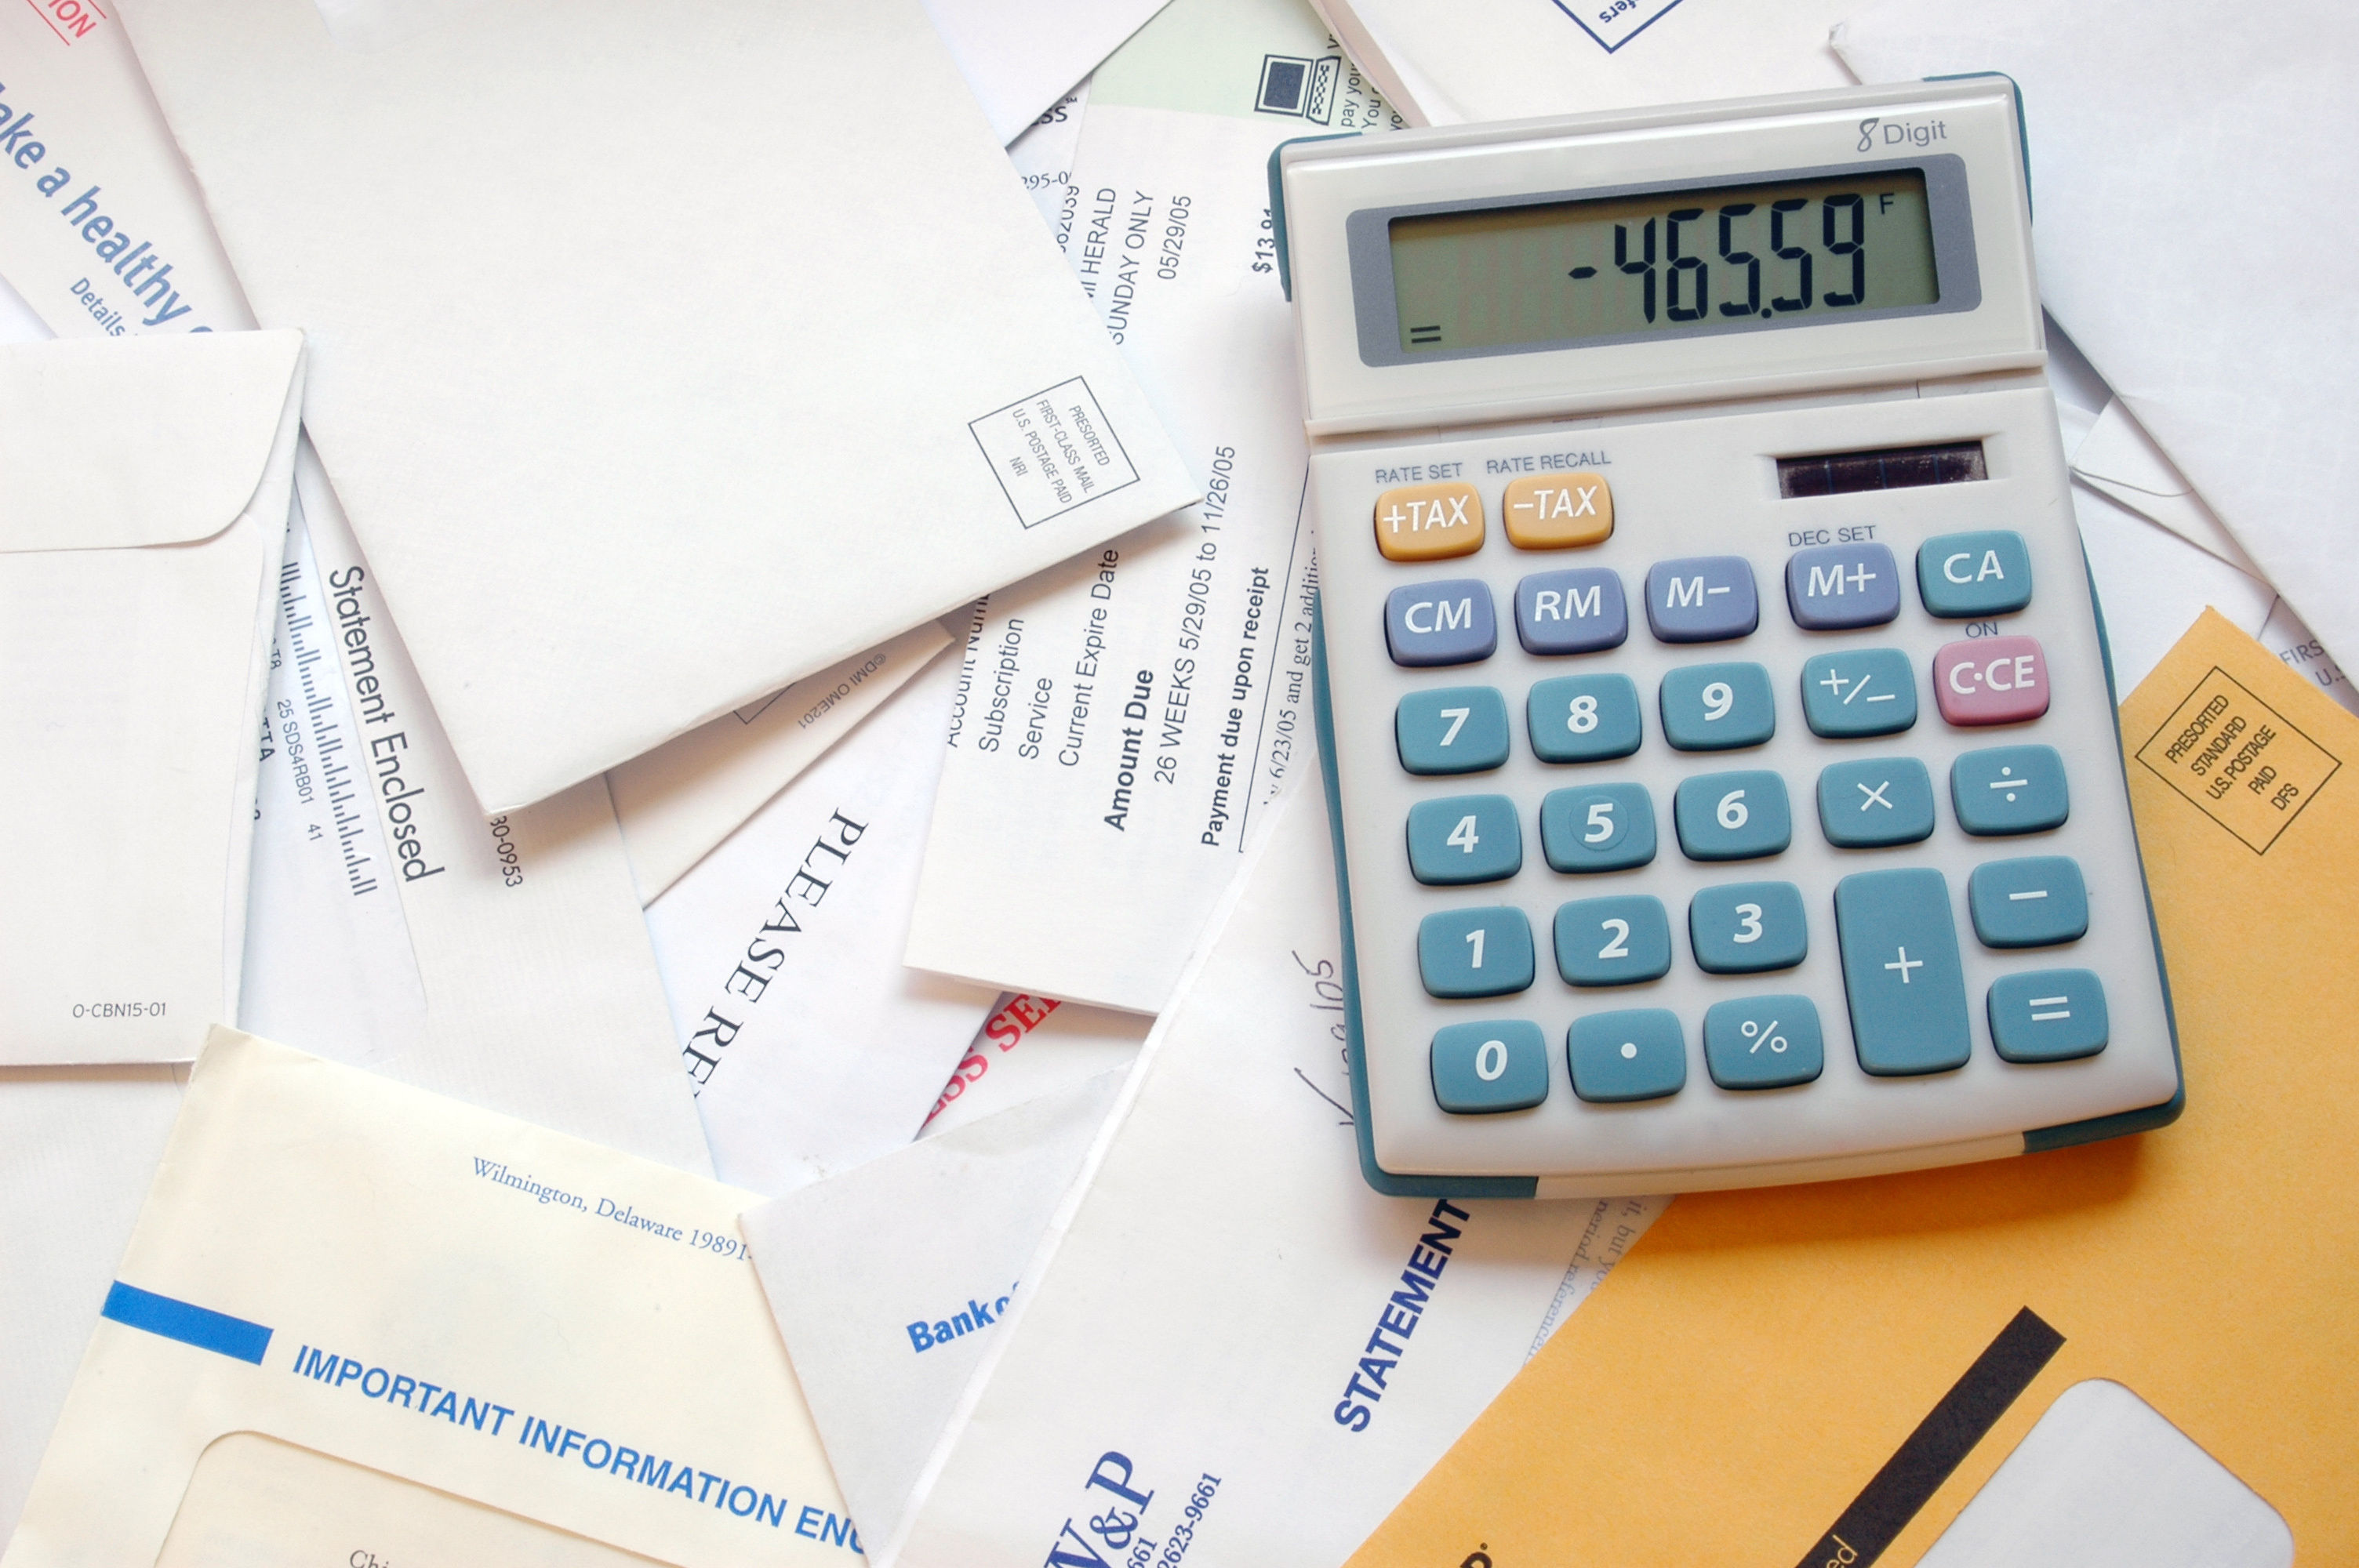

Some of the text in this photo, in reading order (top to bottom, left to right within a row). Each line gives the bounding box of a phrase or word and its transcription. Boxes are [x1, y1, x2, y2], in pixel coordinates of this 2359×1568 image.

[1340, 103, 1357, 128] pay
[1361, 99, 1381, 129] You
[1884, 119, 1947, 149] Digit
[0, 82, 192, 326] ake a healthy
[1081, 187, 1116, 274] HERALD
[1157, 195, 1192, 280] 05/29/05
[1107, 191, 1154, 346] SUNDAY ONLY
[1569, 193, 1895, 325] -465.59 F
[70, 277, 125, 336] Details
[1012, 408, 1073, 503] U.S. POSTAGE PAID
[1036, 399, 1095, 494] FIRST-CLASS MAIL
[1068, 405, 1110, 466] PRESORTED
[1009, 456, 1028, 477] NRI
[1376, 463, 1462, 485] RATE SET
[1486, 450, 1612, 475] RATE RECALL
[1383, 496, 1469, 535] +TAX
[1789, 524, 1877, 548] DEC SET
[1807, 562, 1877, 597] M+
[1943, 550, 2005, 585] CA
[1154, 445, 1236, 785] 26 WEEKS 5/29/05 to 11/26/05
[1404, 597, 1474, 635] CM
[1534, 585, 1602, 622] RM
[1295, 622, 1312, 633] 2
[1965, 622, 1999, 639] ON
[1058, 549, 1119, 767] Current Expire Date
[1294, 636, 1311, 666] get
[978, 617, 1025, 753] Subscription
[1286, 670, 1304, 704] and
[1702, 682, 1733, 721] 9
[329, 564, 445, 883] Statement Enclosed
[797, 684, 851, 729] OME201
[1018, 677, 1053, 760] Service
[1201, 567, 1269, 846] Payment due upon receipt
[1439, 707, 1470, 746] 7
[1568, 695, 1600, 734] 8
[2165, 694, 2229, 764] PRESORTED
[2190, 715, 2247, 777] STANDARD
[277, 699, 324, 841] 25 SDS4RB01 41
[1103, 669, 1154, 832] Amount Due
[2205, 724, 2277, 800] U.S. POSTAGE
[2248, 765, 2277, 796] PAID
[2270, 782, 2299, 811] DFS
[1584, 803, 1616, 842] 5
[1716, 789, 1748, 829] 6
[1447, 815, 1479, 854] 4
[1598, 919, 1630, 959] 2
[1732, 903, 1764, 943] 3
[682, 807, 869, 1098] PLEASE RE
[1464, 929, 1486, 969] 1
[1741, 1020, 1788, 1054] %
[1475, 1039, 1508, 1081] 0
[472, 1156, 587, 1214] Wilmington,
[594, 1197, 683, 1241] Delaware
[906, 1299, 995, 1353] Bank
[1334, 1198, 1470, 1432] STATEMENT
[292, 1345, 515, 1437] IMPORTANT
[518, 1416, 788, 1527] INFORMATION
